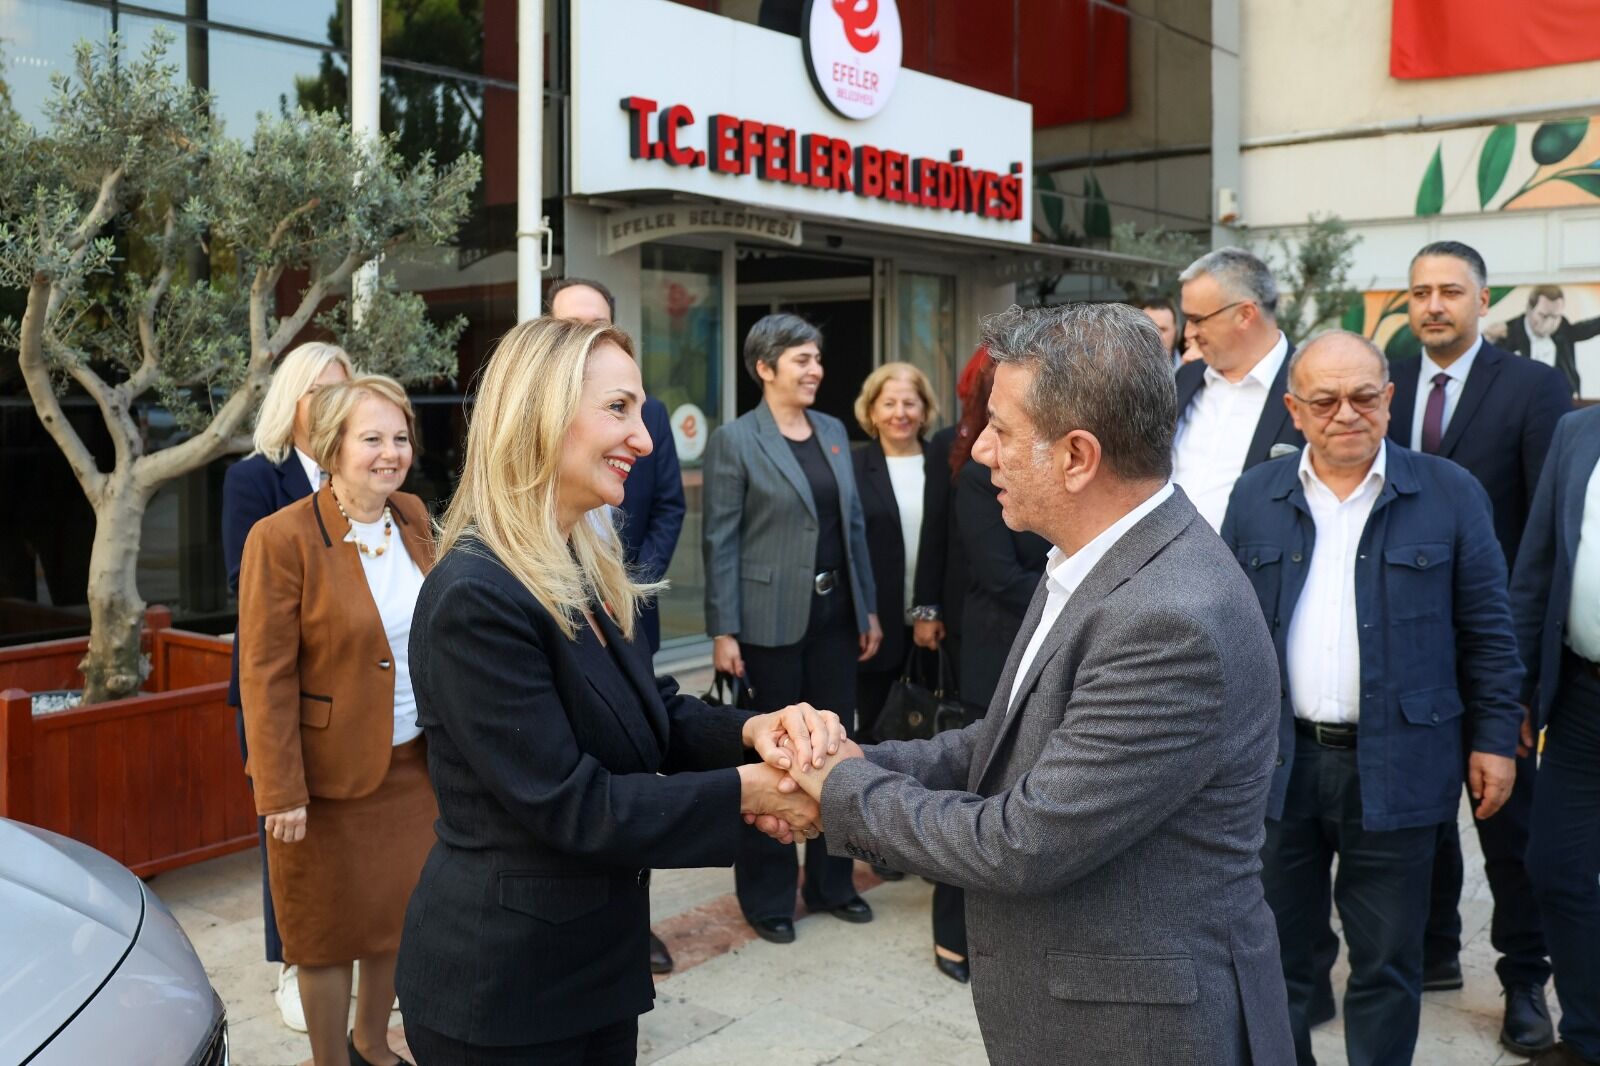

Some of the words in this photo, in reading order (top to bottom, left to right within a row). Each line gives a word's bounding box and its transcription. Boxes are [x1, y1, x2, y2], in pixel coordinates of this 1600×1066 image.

[832, 61, 880, 92] EFELER
[620, 96, 706, 167] T.C.
[708, 113, 853, 191] EFELER
[854, 145, 1022, 221] BELEDİYESİ
[612, 211, 676, 240] EFELER
